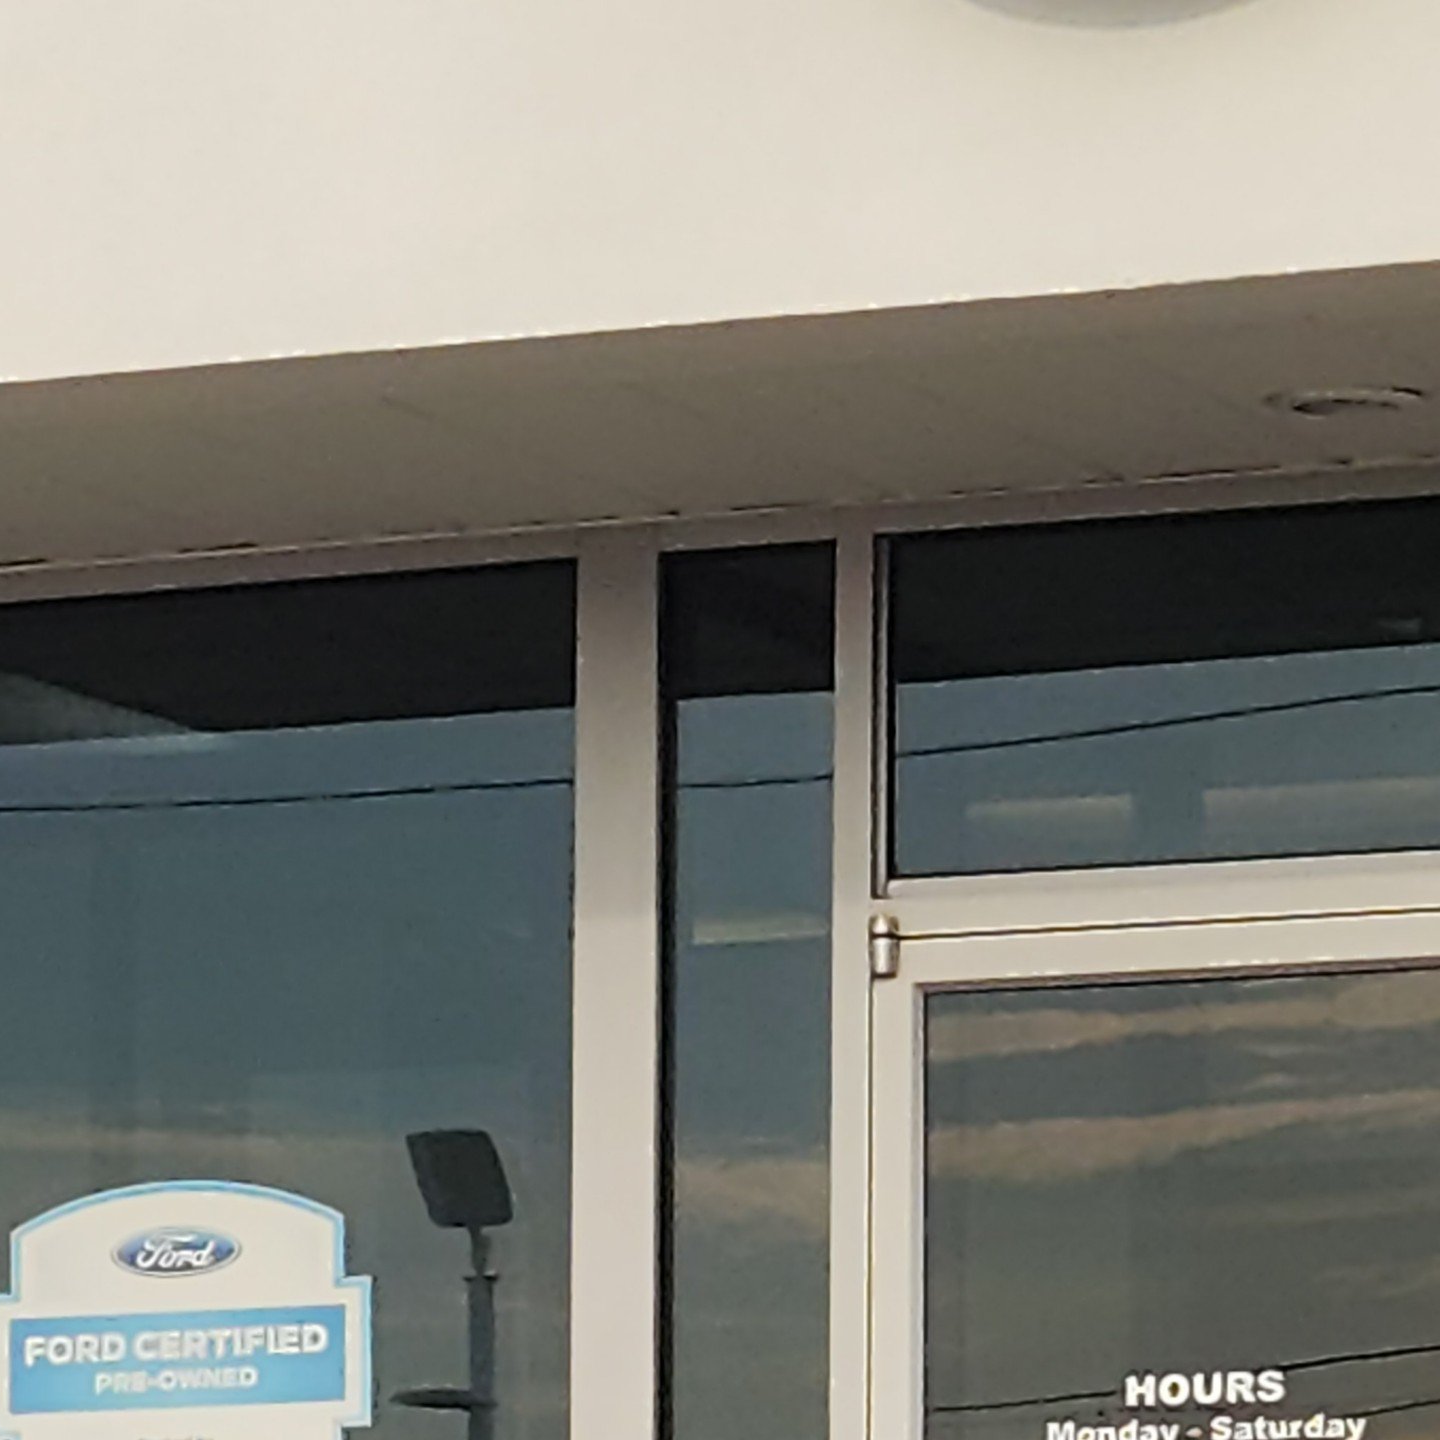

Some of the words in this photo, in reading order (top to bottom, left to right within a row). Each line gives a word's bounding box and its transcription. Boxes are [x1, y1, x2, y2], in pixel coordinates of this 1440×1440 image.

[136, 1232, 216, 1268] Ford
[24, 1332, 125, 1367] FORD
[133, 1323, 329, 1361] CERTIFIED
[93, 1366, 259, 1396] PRE-OWNED
[1124, 1370, 1287, 1407] HOURS
